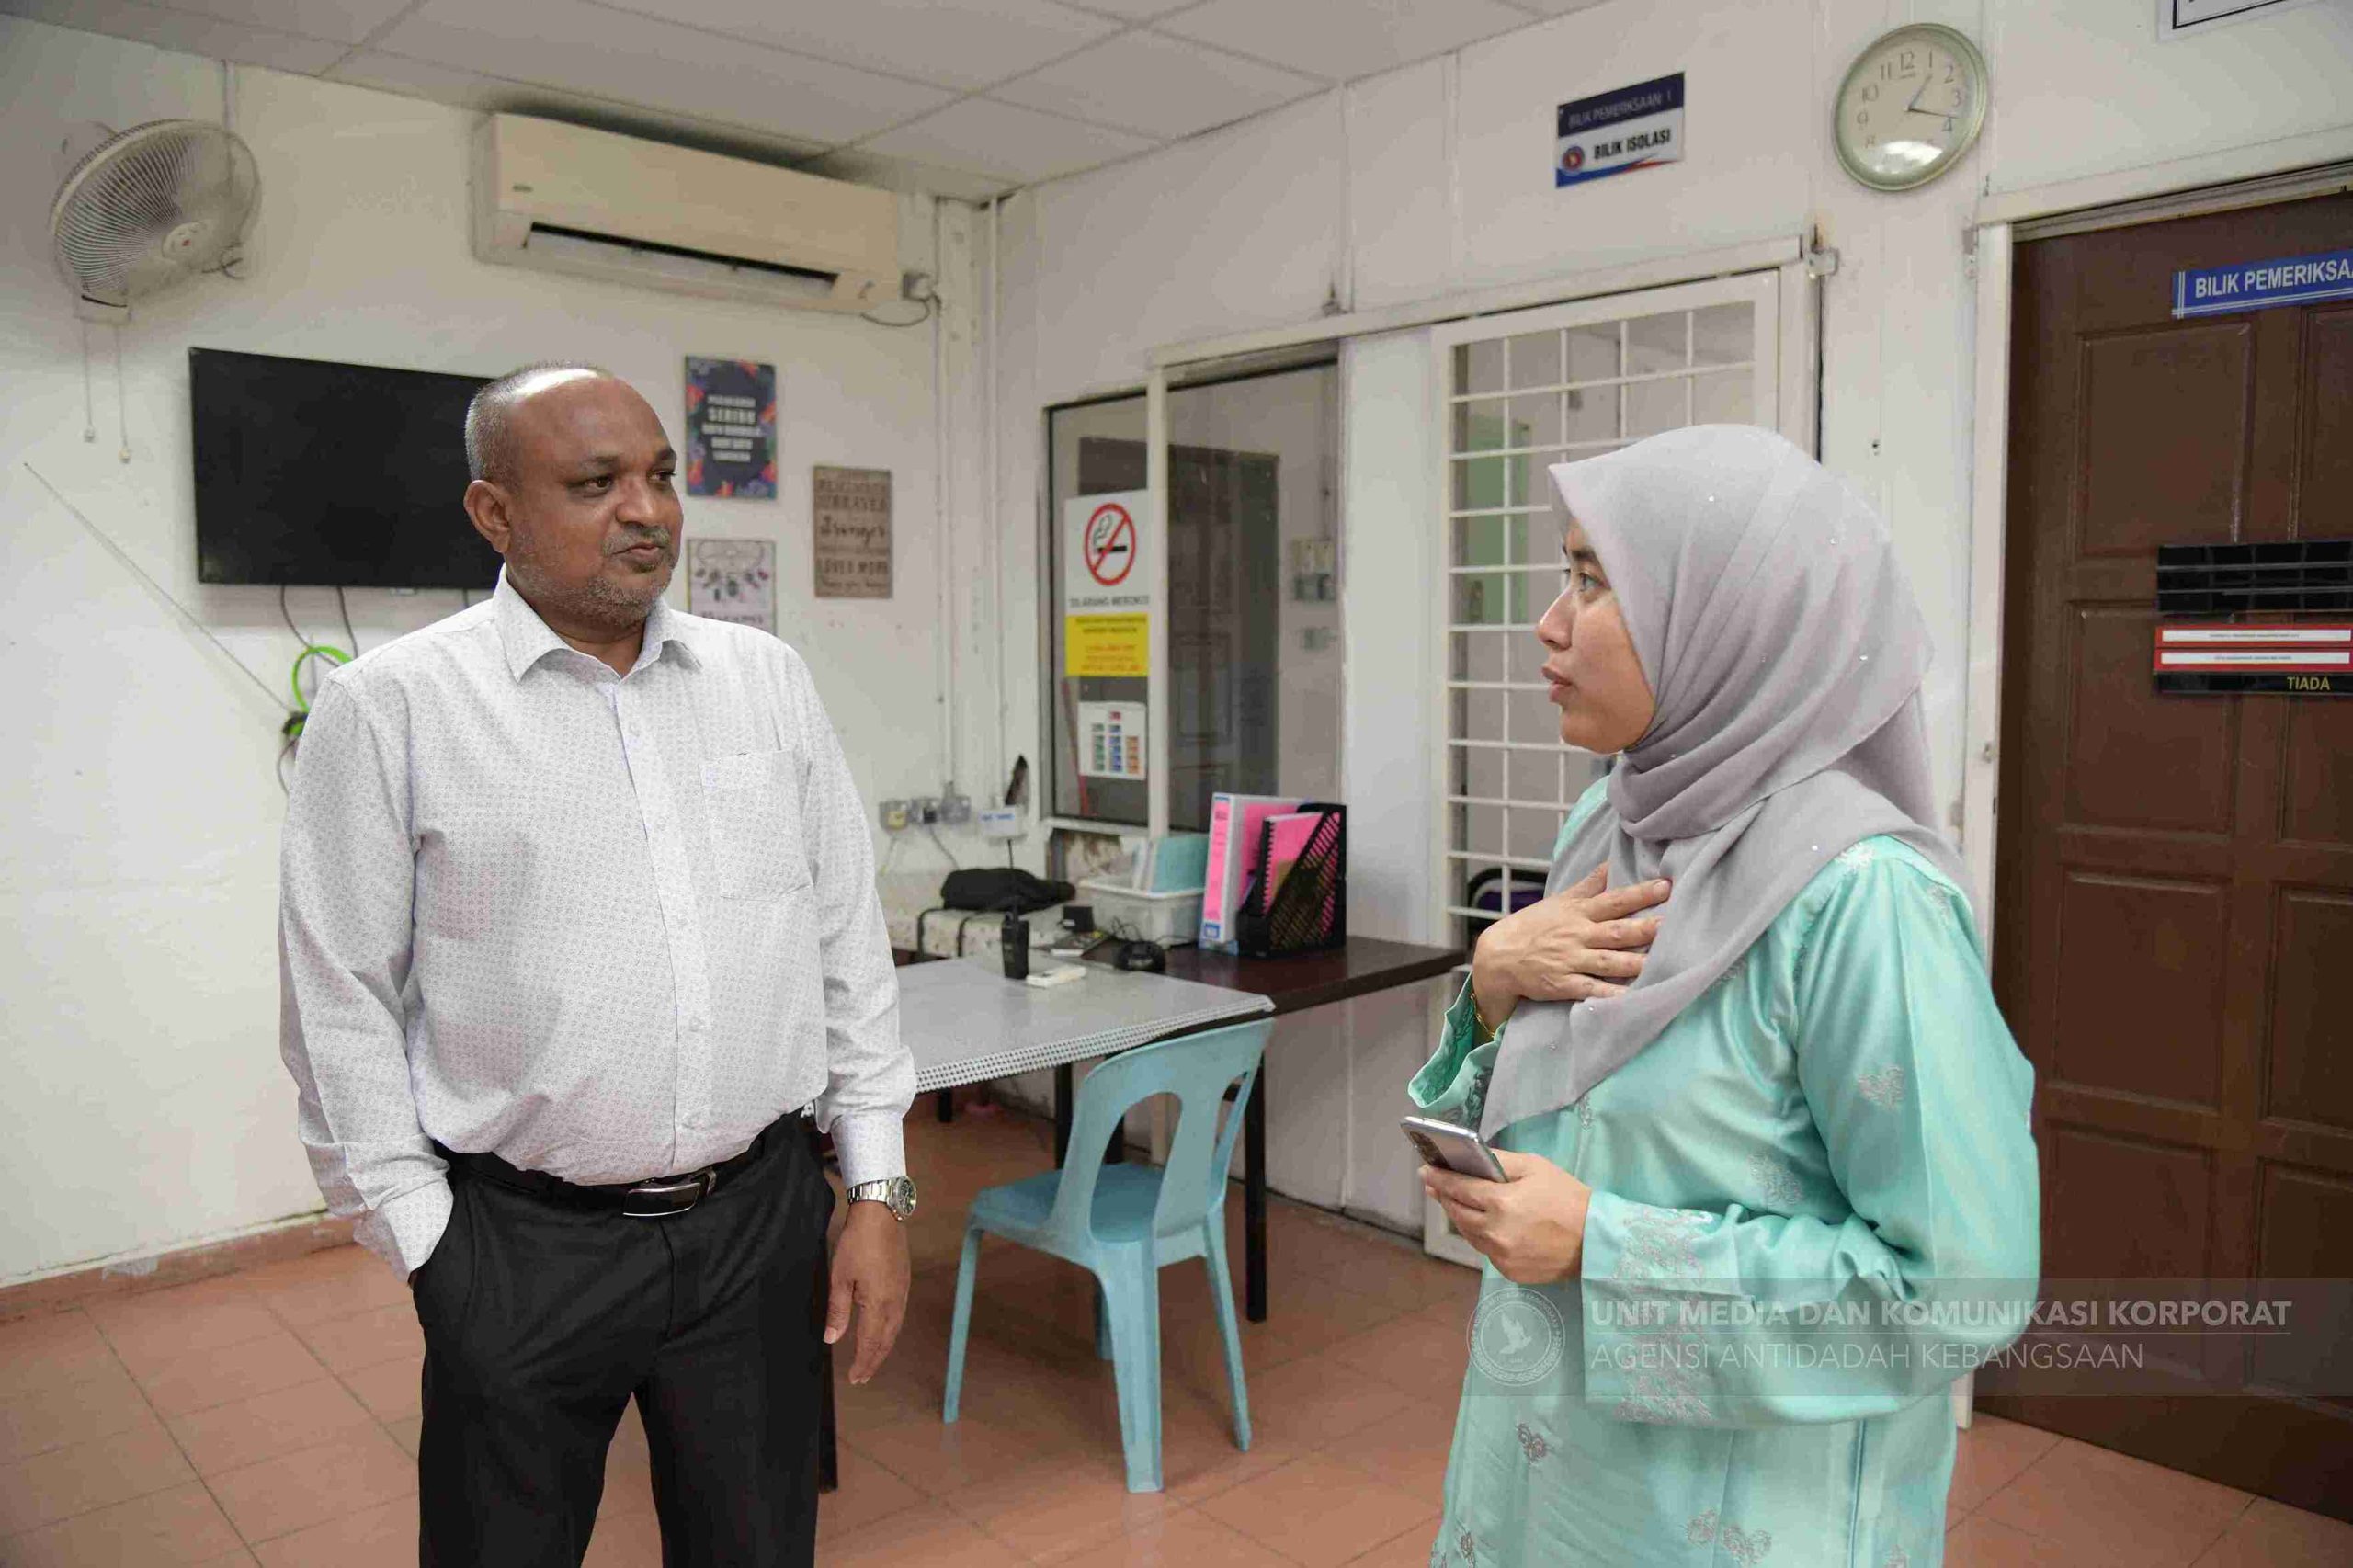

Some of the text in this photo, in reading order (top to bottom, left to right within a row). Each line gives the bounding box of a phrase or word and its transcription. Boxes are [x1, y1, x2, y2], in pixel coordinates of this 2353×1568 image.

[1880, 62, 1892, 80] 11
[1900, 51, 1915, 71] 12
[1944, 64, 1954, 84] 2
[1862, 84, 1879, 102] 10
[1951, 88, 1962, 108] 3
[1594, 128, 1672, 160] BILIK ISOLASI
[2195, 258, 2353, 299] BILIK PEMERIKSA
[2286, 676, 2331, 691] TIADA
